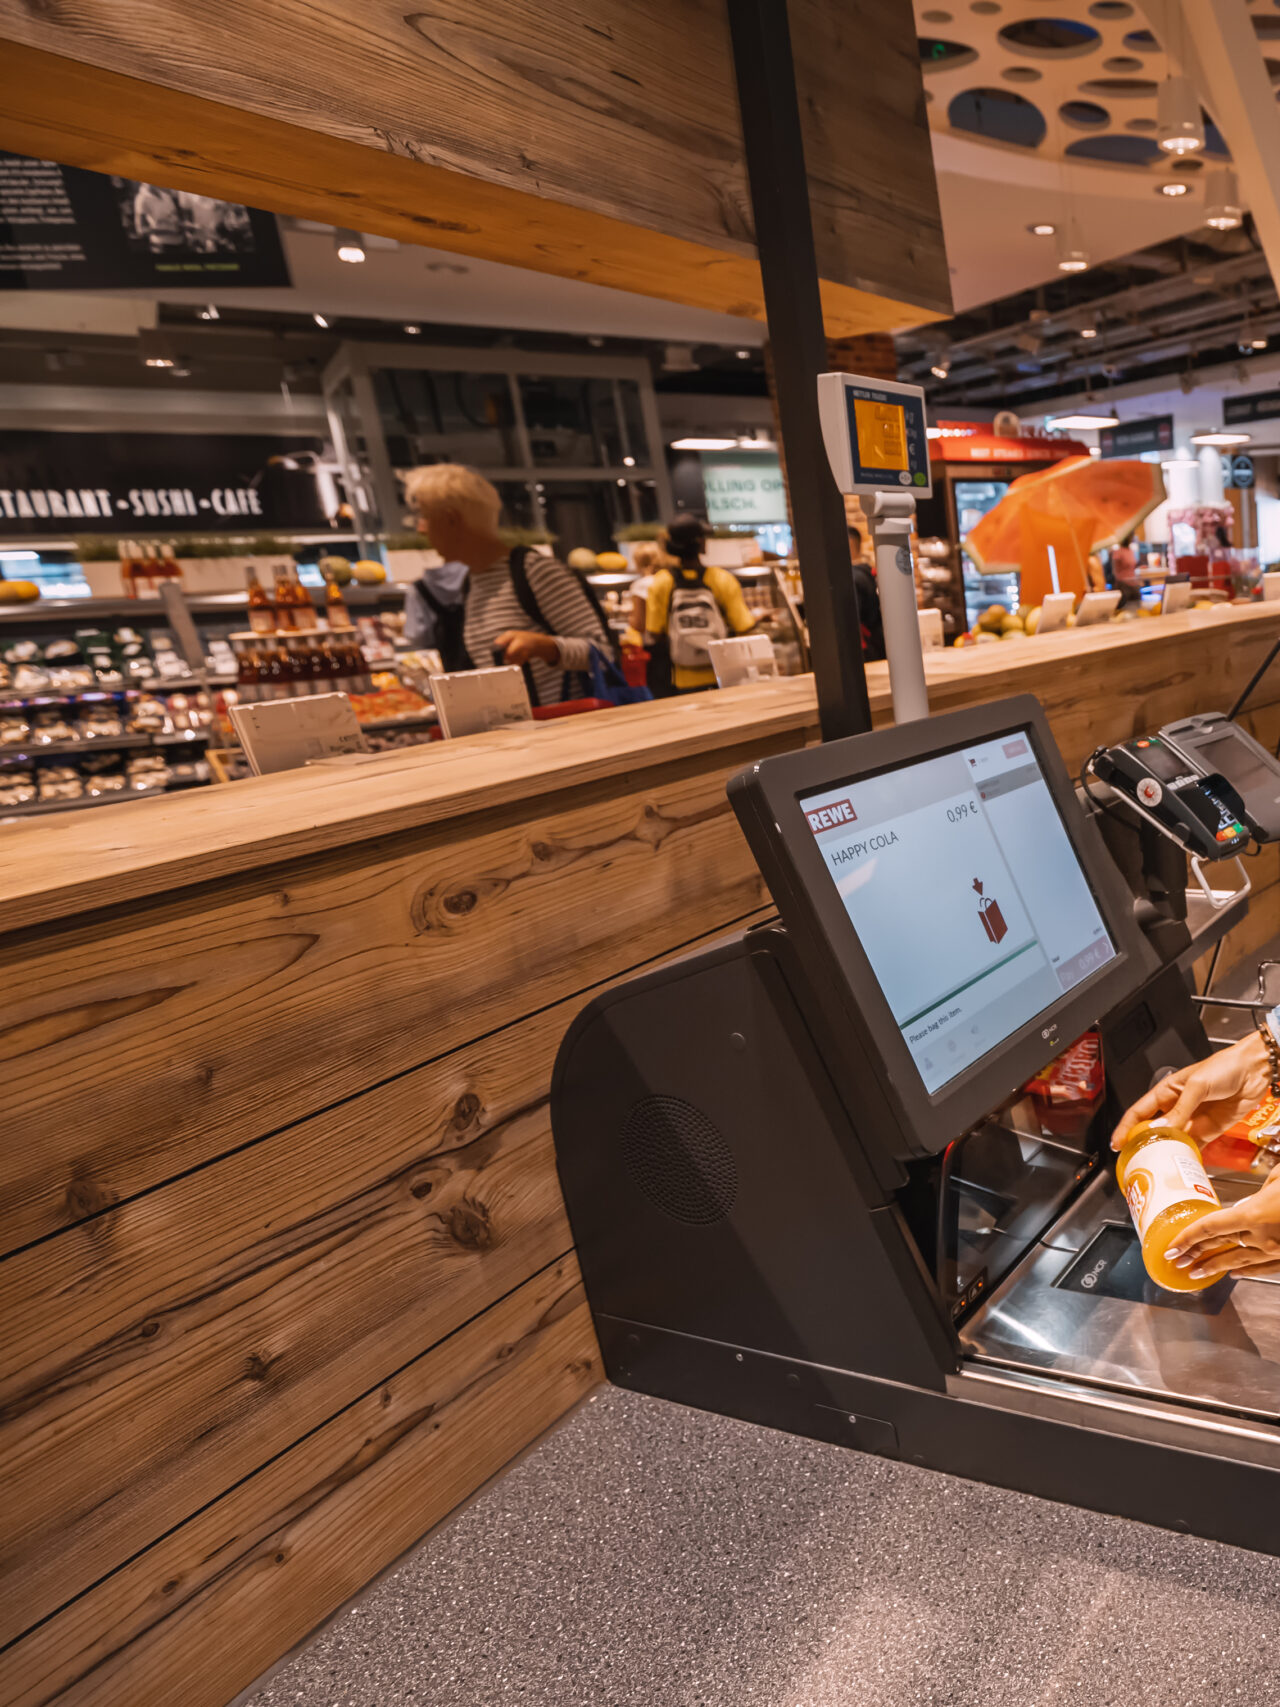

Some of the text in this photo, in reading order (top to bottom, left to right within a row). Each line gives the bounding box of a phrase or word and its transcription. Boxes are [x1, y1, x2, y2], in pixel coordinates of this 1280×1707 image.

[0, 489, 113, 517] TAURANT
[129, 489, 198, 516] SUSHI
[807, 802, 855, 831] REWE
[946, 801, 978, 823] 0,99 €
[831, 831, 899, 866] HAPPY COLA
[909, 1029, 928, 1044] Please
[927, 1021, 939, 1032] bag
[938, 1015, 949, 1025] this
[1092, 1259, 1107, 1277] NCR
